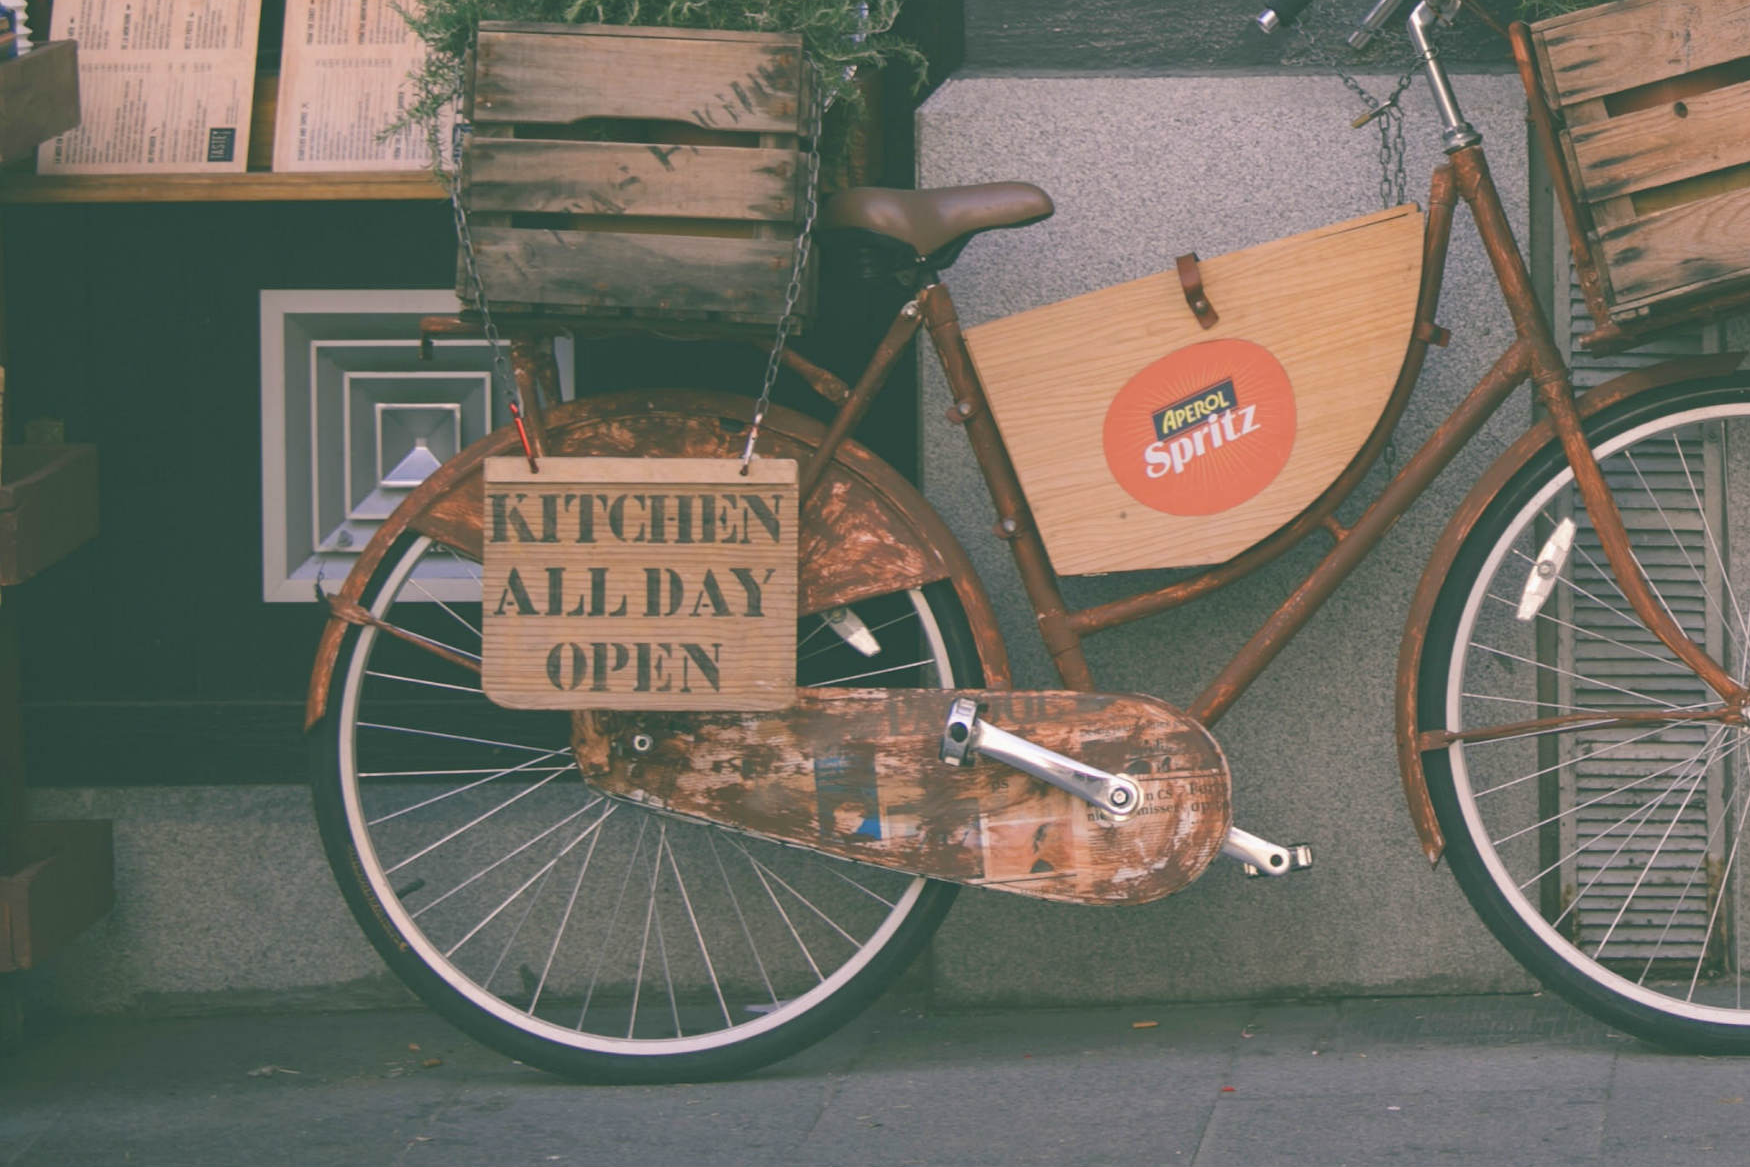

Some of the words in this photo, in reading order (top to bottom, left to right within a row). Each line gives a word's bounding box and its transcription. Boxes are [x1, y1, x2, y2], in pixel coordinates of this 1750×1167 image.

[1162, 391, 1230, 434] APEROL
[1144, 404, 1261, 479] Spritz
[488, 494, 784, 545] KITCHEN
[494, 567, 628, 617] ALL
[642, 567, 777, 618] DAY
[546, 642, 723, 694] OPEN
